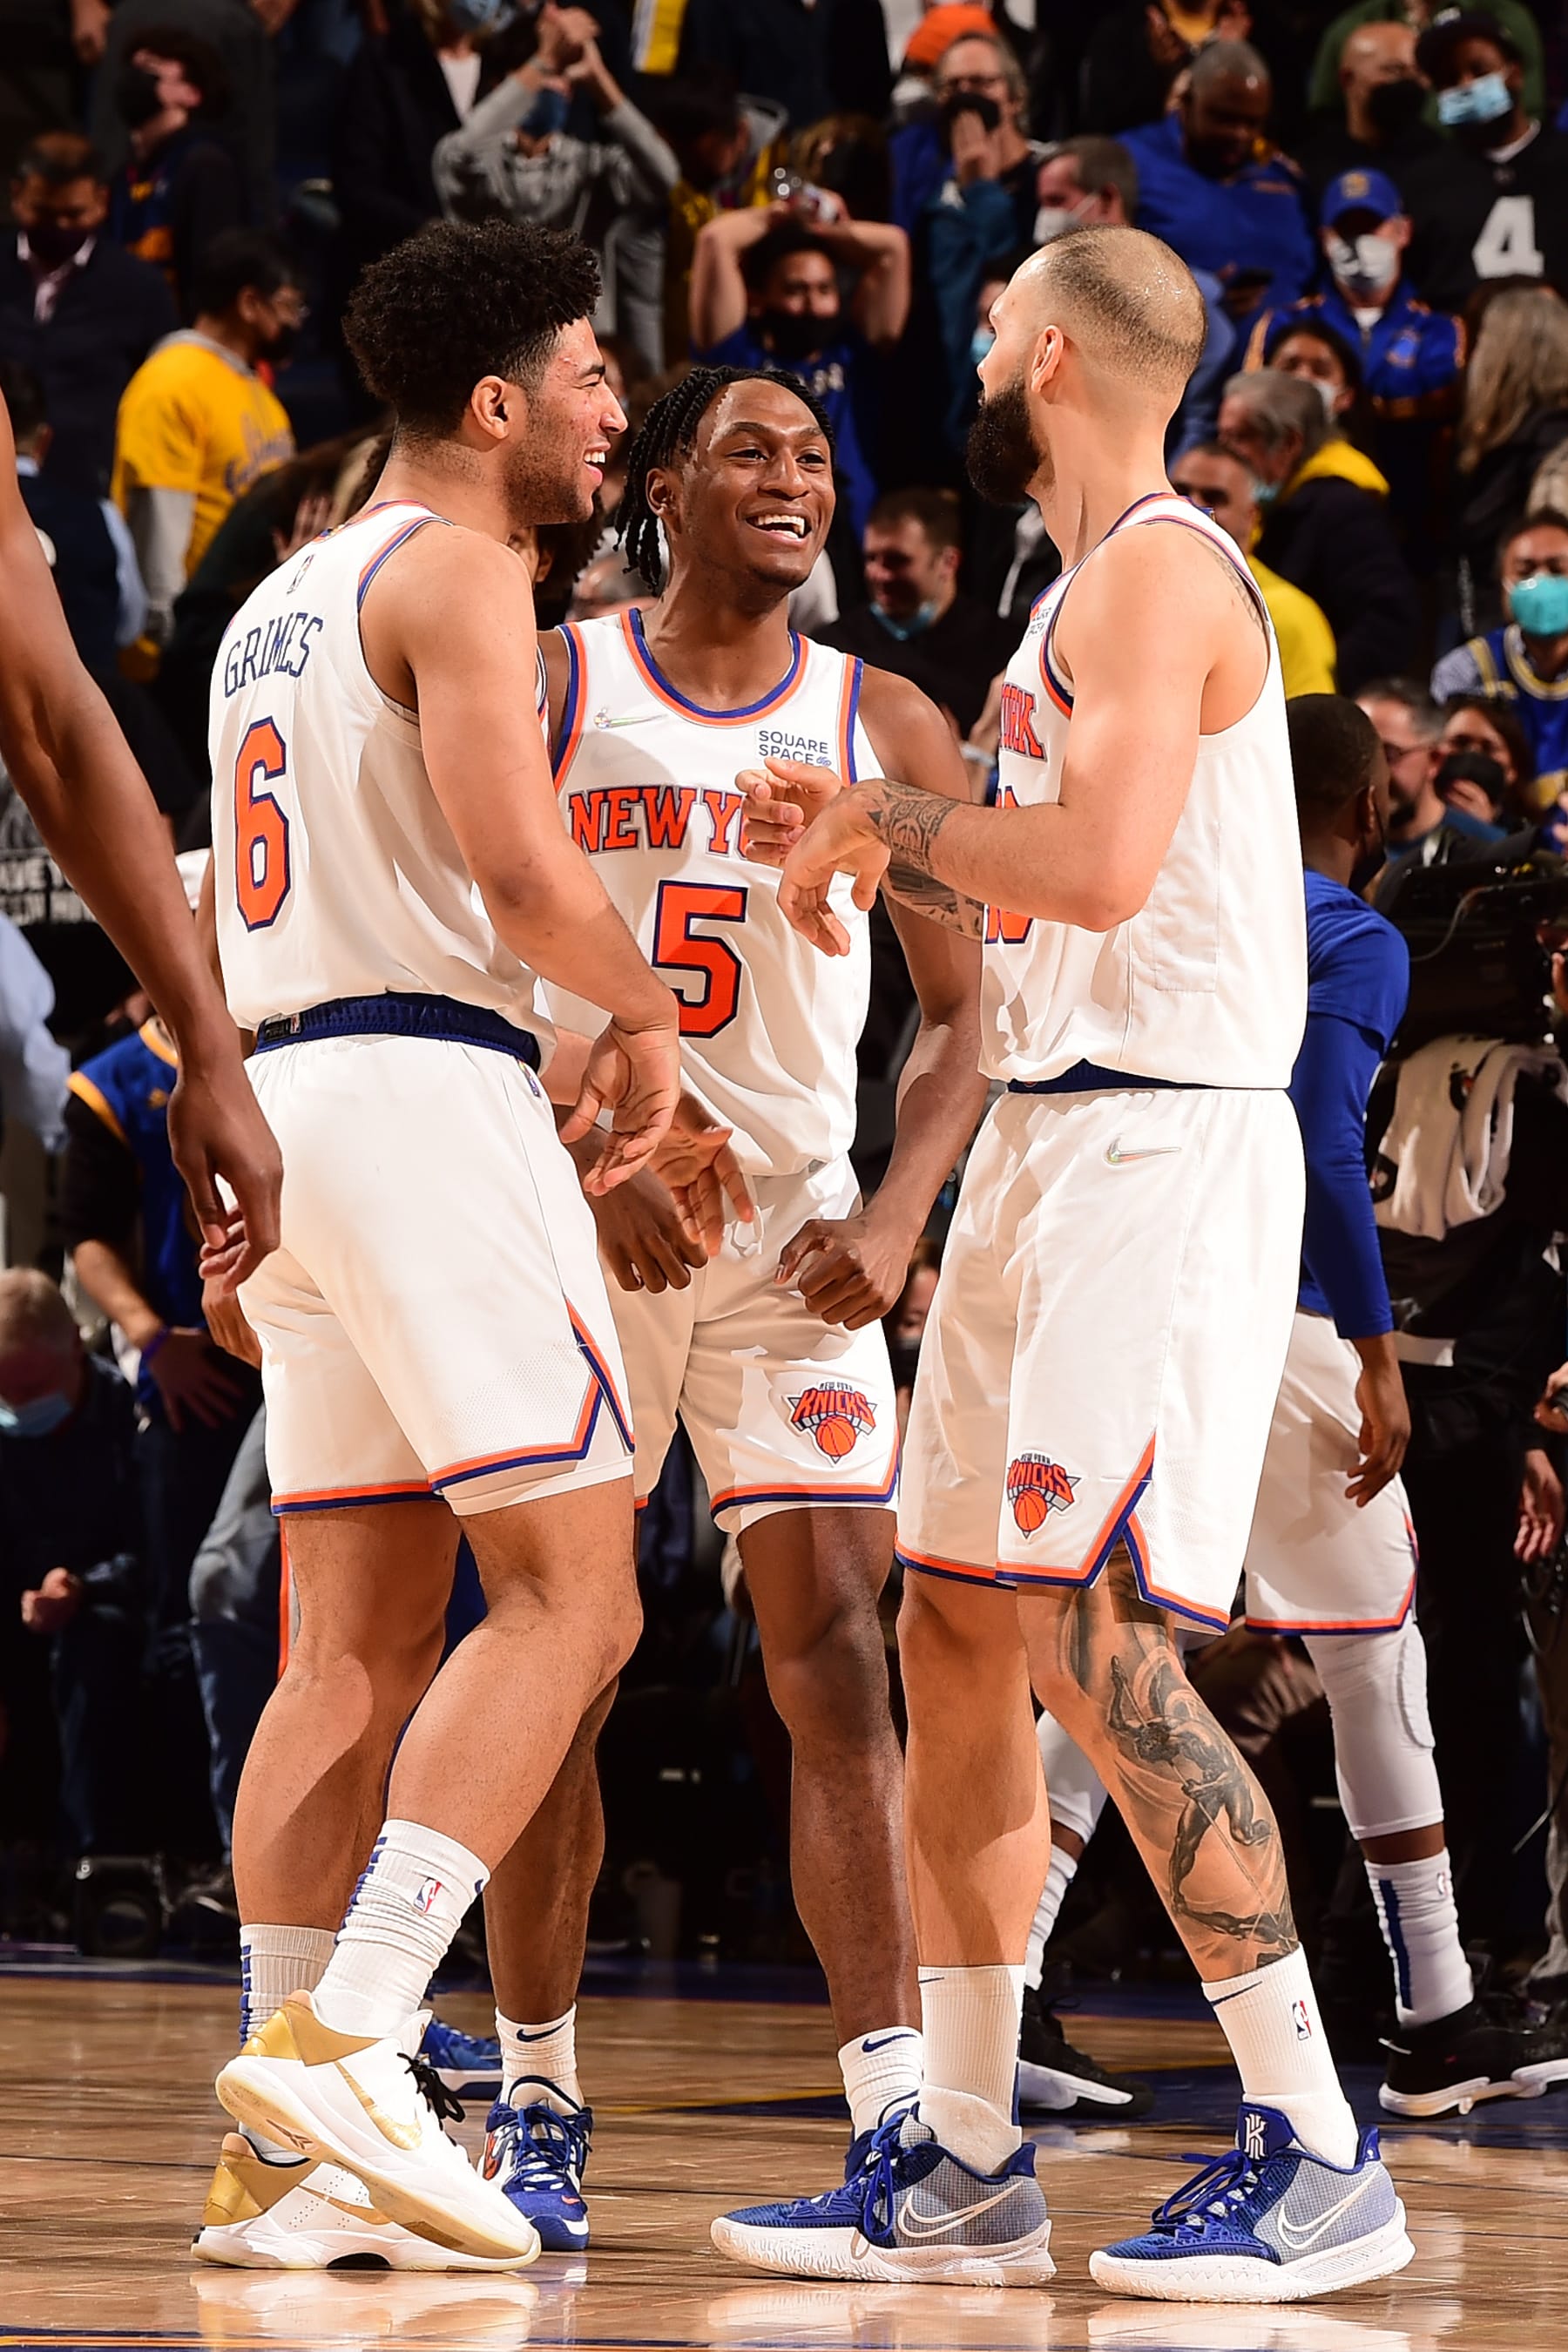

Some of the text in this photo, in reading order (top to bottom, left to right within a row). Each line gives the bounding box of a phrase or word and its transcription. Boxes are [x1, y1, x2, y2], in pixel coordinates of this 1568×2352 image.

[1471, 195, 1544, 279] 4
[224, 612, 324, 698] GRIMES
[759, 730, 829, 754] SQUARE
[759, 744, 814, 766] SPACE
[234, 715, 291, 933] 6
[568, 784, 698, 855] NEW
[652, 879, 749, 1039] 5
[790, 1387, 877, 1429] KNICKS
[1007, 1458, 1075, 1504] KNICKS
